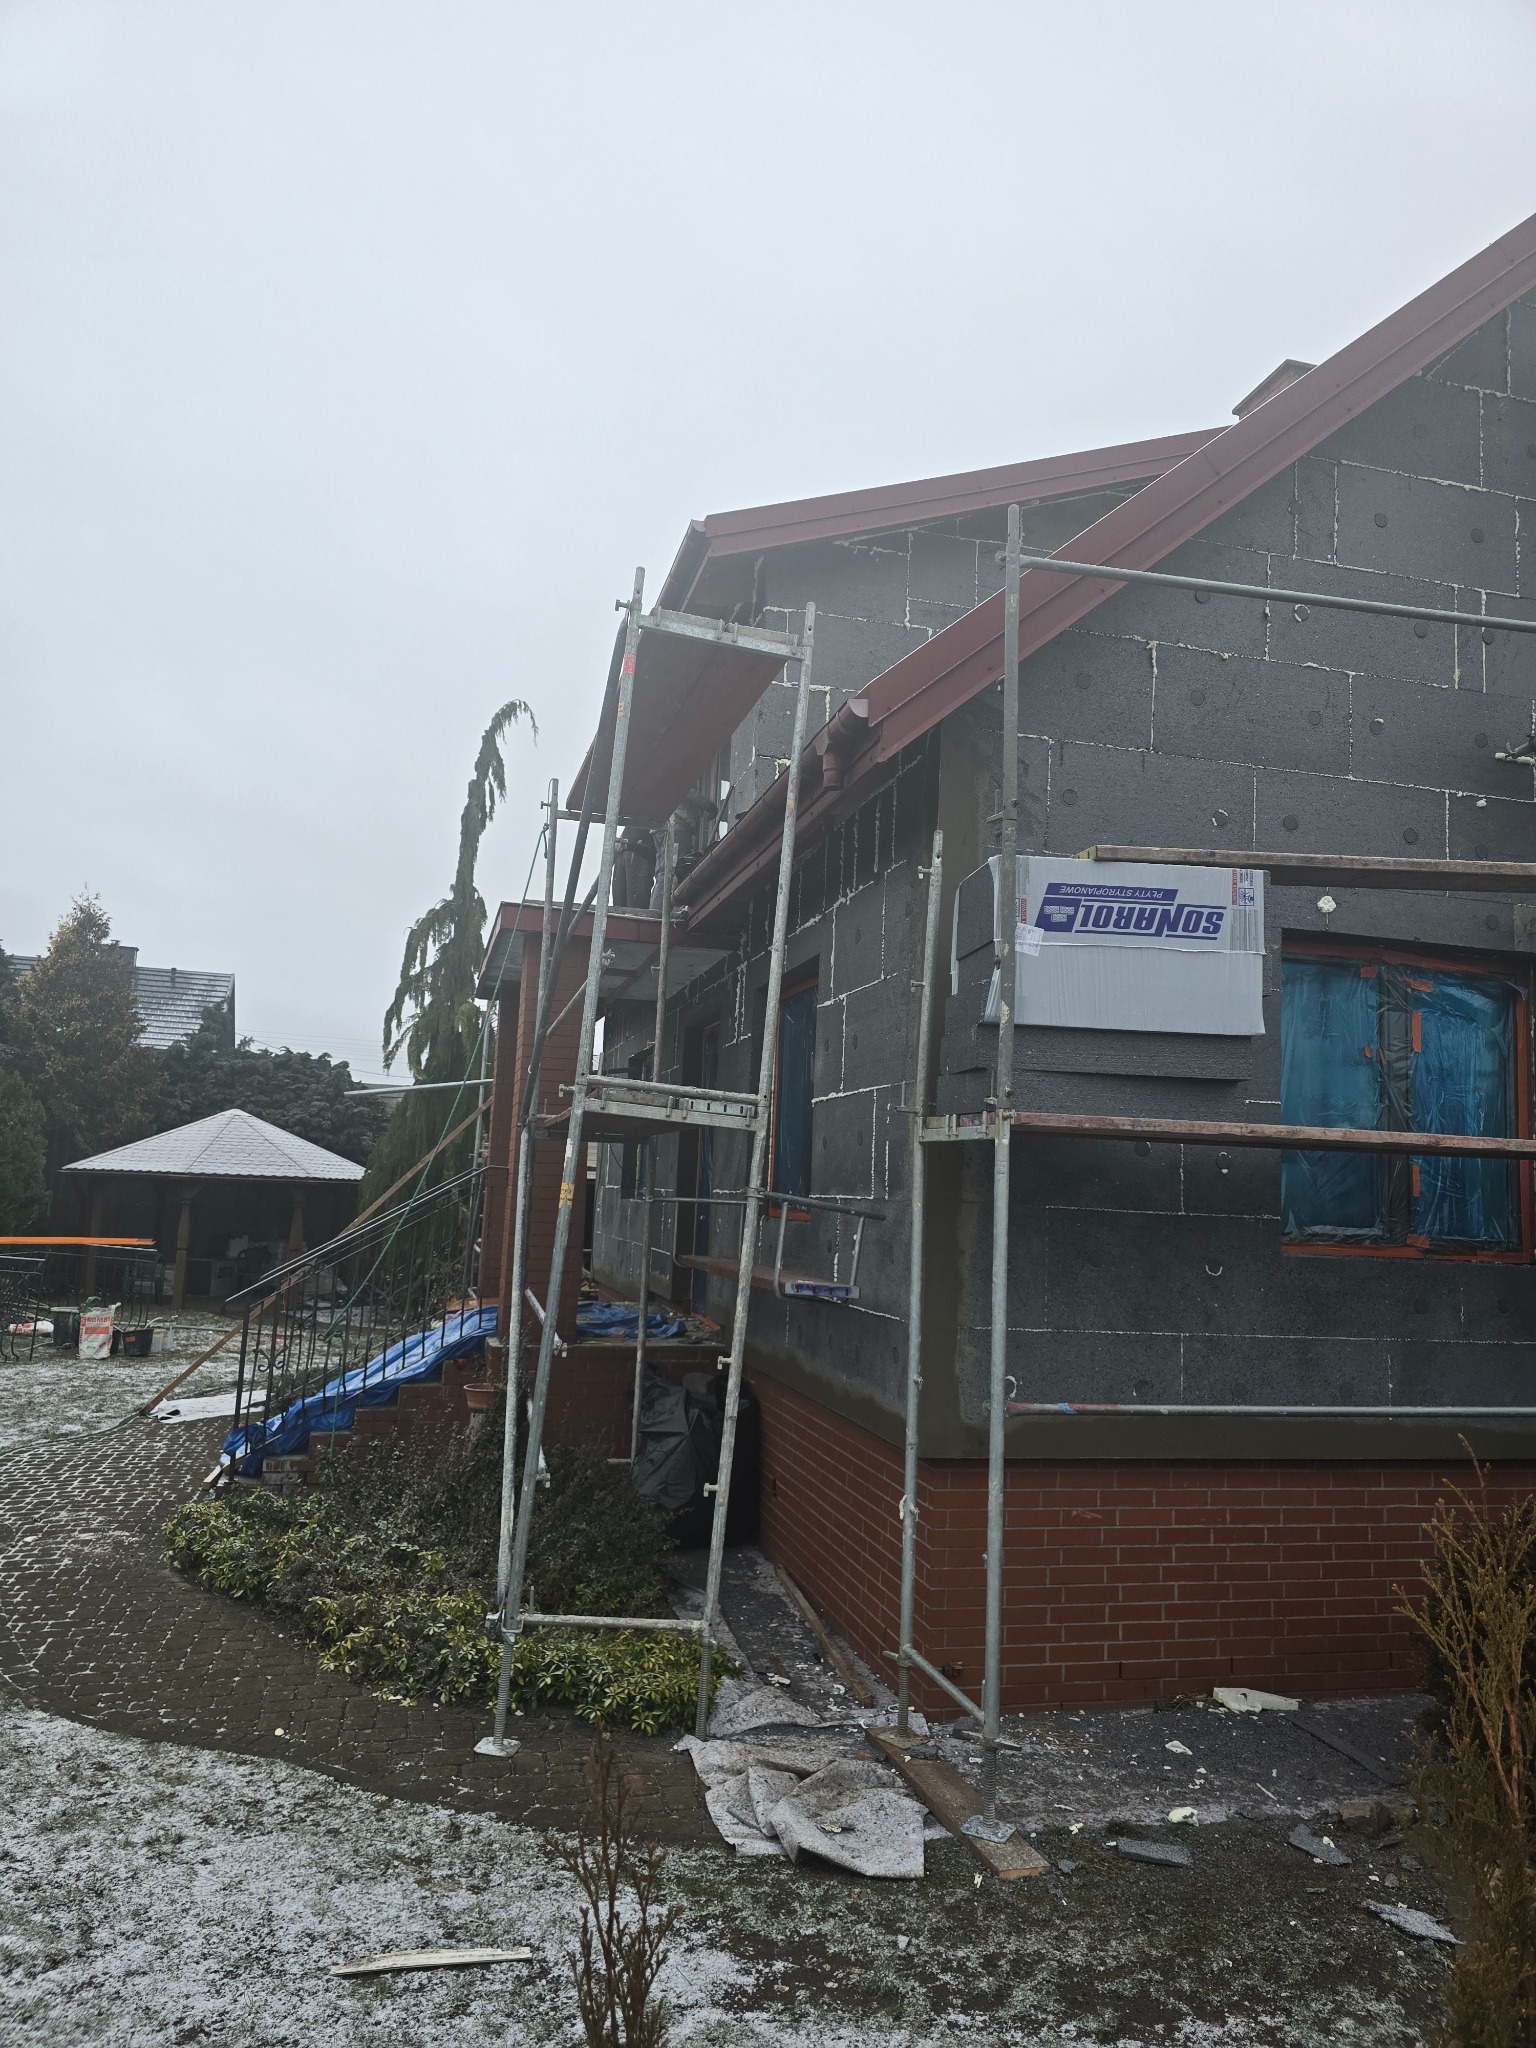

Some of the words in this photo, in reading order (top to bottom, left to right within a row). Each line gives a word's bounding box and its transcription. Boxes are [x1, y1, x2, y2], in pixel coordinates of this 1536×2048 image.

[1059, 885, 1133, 898] STYROPIANOWE
[1134, 890, 1164, 900] PŁYTY
[1080, 904, 1225, 937] SONAROL
